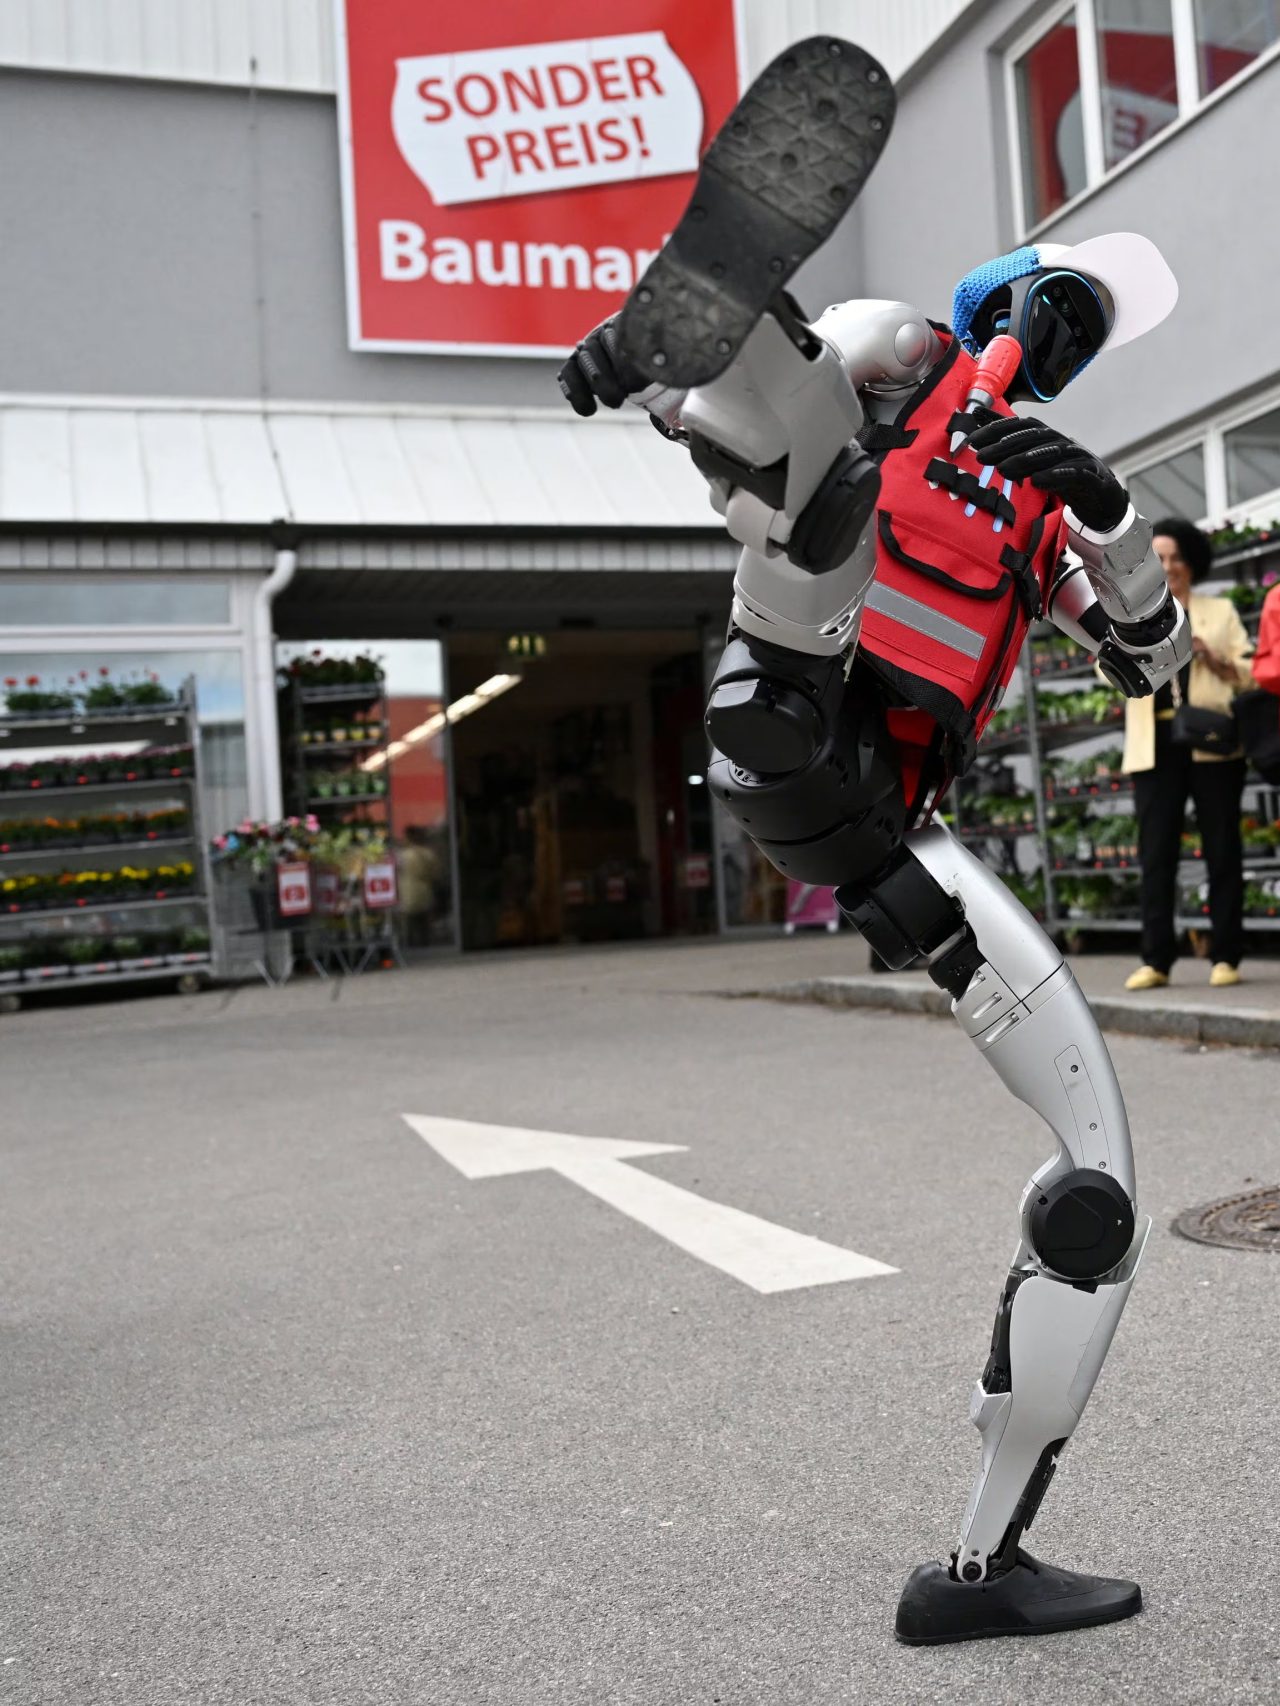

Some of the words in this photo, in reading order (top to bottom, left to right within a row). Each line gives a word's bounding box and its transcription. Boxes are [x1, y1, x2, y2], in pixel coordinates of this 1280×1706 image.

[416, 55, 665, 124] SONDER
[465, 114, 651, 180] PREIS!
[378, 219, 672, 292] Baumar
